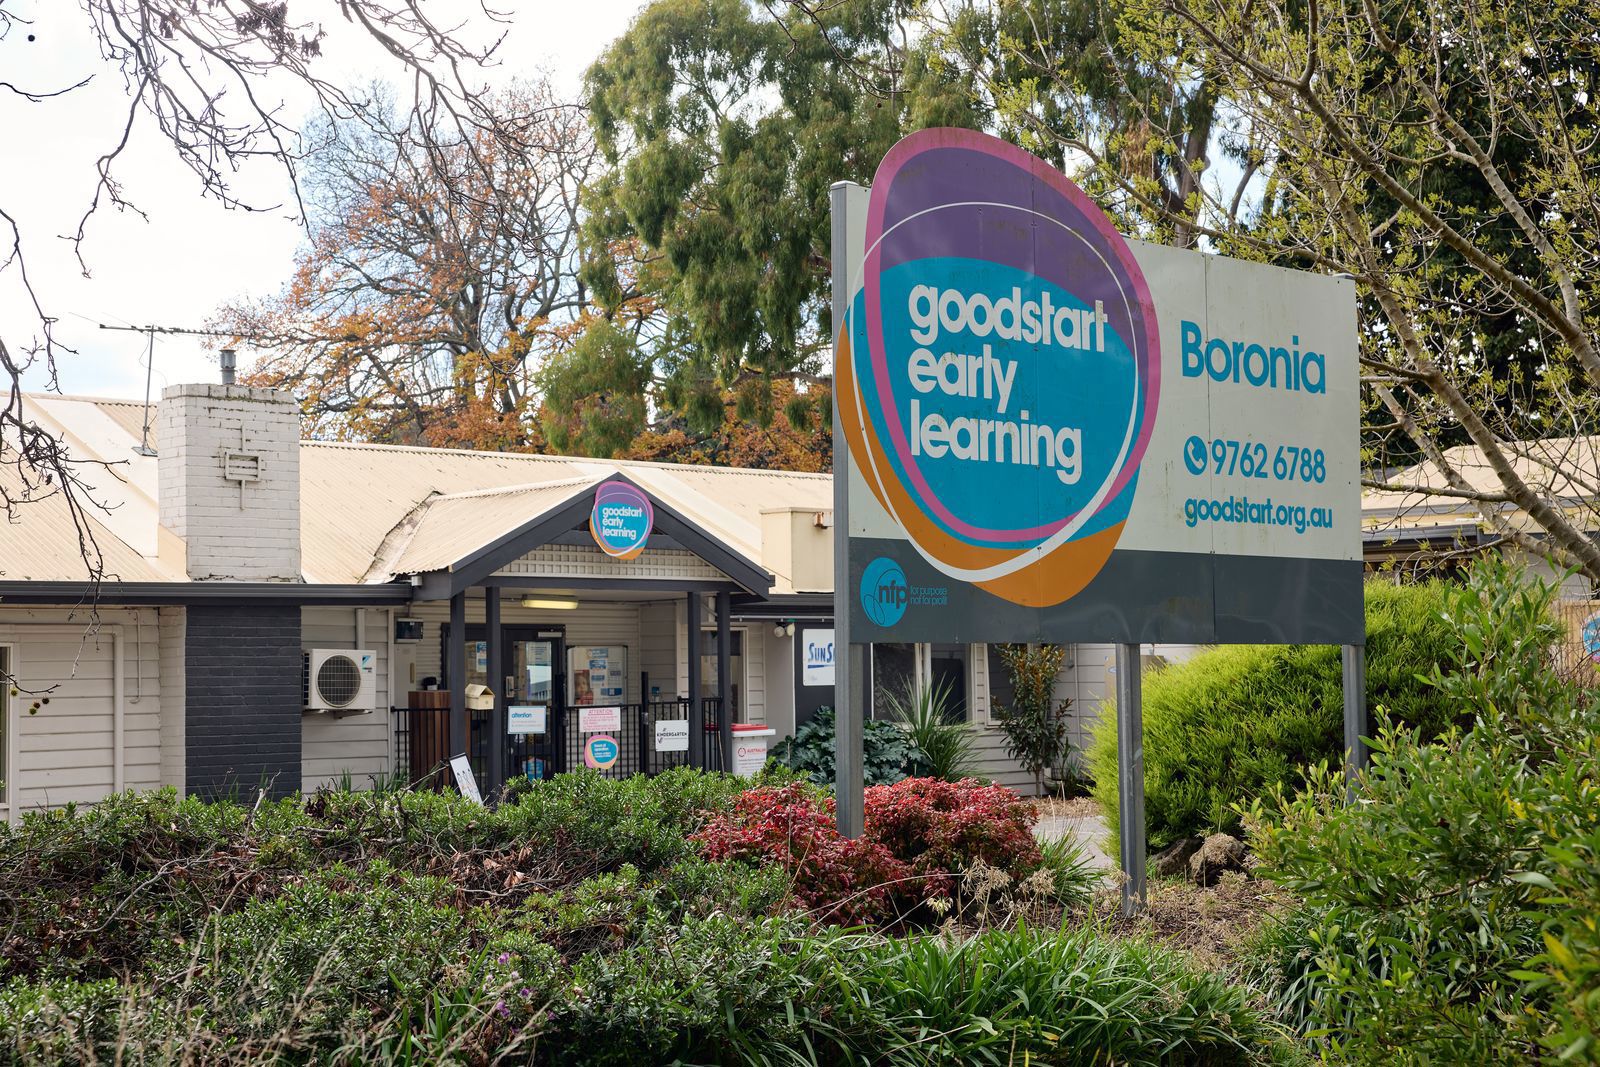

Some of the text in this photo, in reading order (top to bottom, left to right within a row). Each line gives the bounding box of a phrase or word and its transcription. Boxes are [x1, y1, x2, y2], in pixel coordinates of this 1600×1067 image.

[908, 284, 1108, 353] goodstart
[1180, 319, 1326, 395] Boronia
[908, 343, 1018, 414] early
[910, 398, 1082, 485] learning
[1211, 438, 1326, 484] 9762 6788
[602, 507, 642, 518] goodstart
[602, 517, 624, 528] early
[1184, 495, 1333, 535] goodstart.org.au
[602, 526, 637, 540] learning
[879, 579, 907, 610] nfp
[910, 585, 947, 597] for purpose
